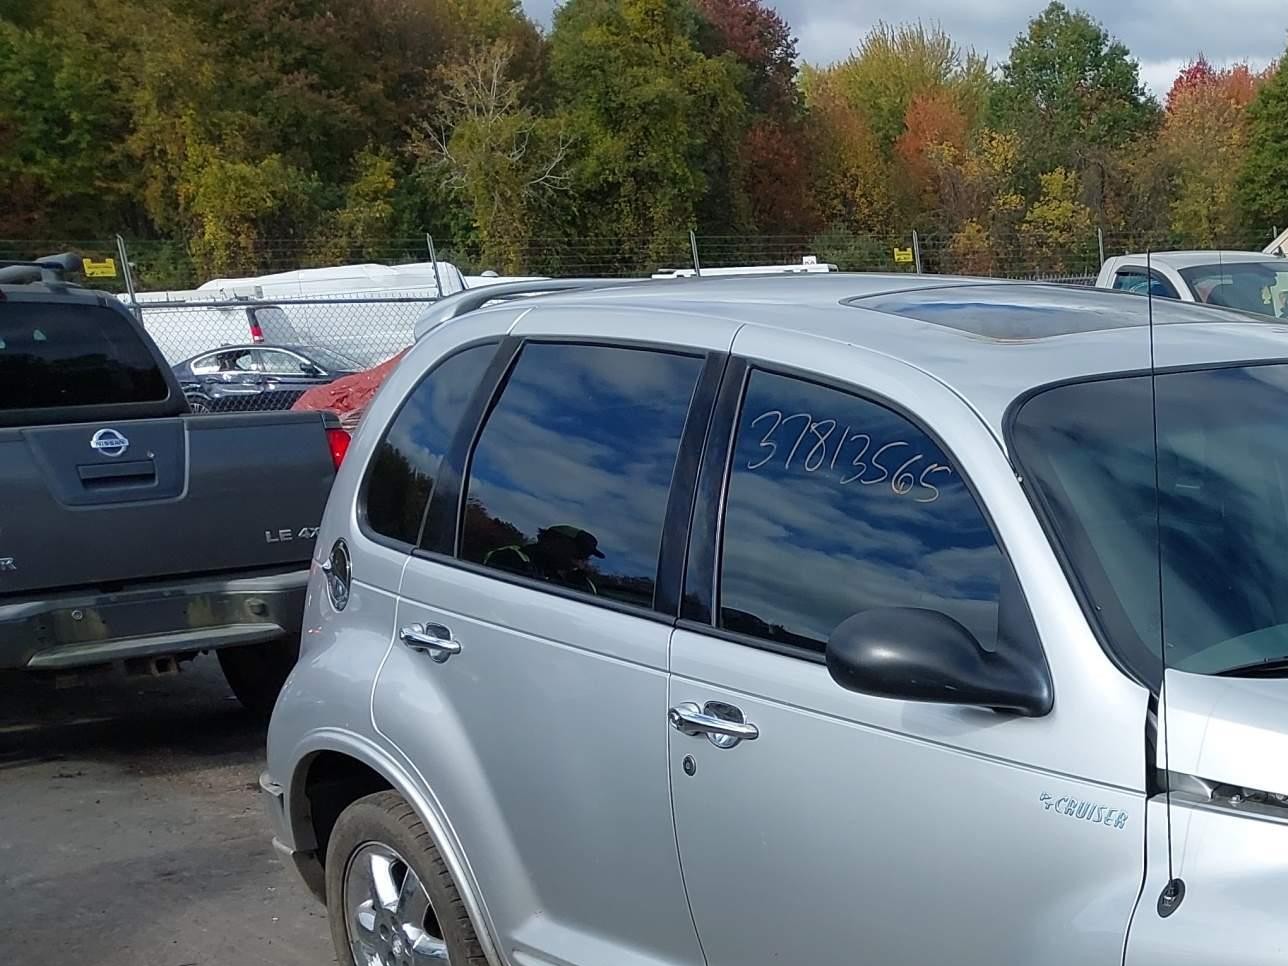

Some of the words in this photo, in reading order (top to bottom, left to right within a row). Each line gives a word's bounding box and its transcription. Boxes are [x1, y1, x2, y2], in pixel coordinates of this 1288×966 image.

[747, 410, 952, 503] 37813565
[264, 529, 293, 543] LE
[298, 527, 321, 539] 4X
[1055, 797, 1129, 829] CRUISER
